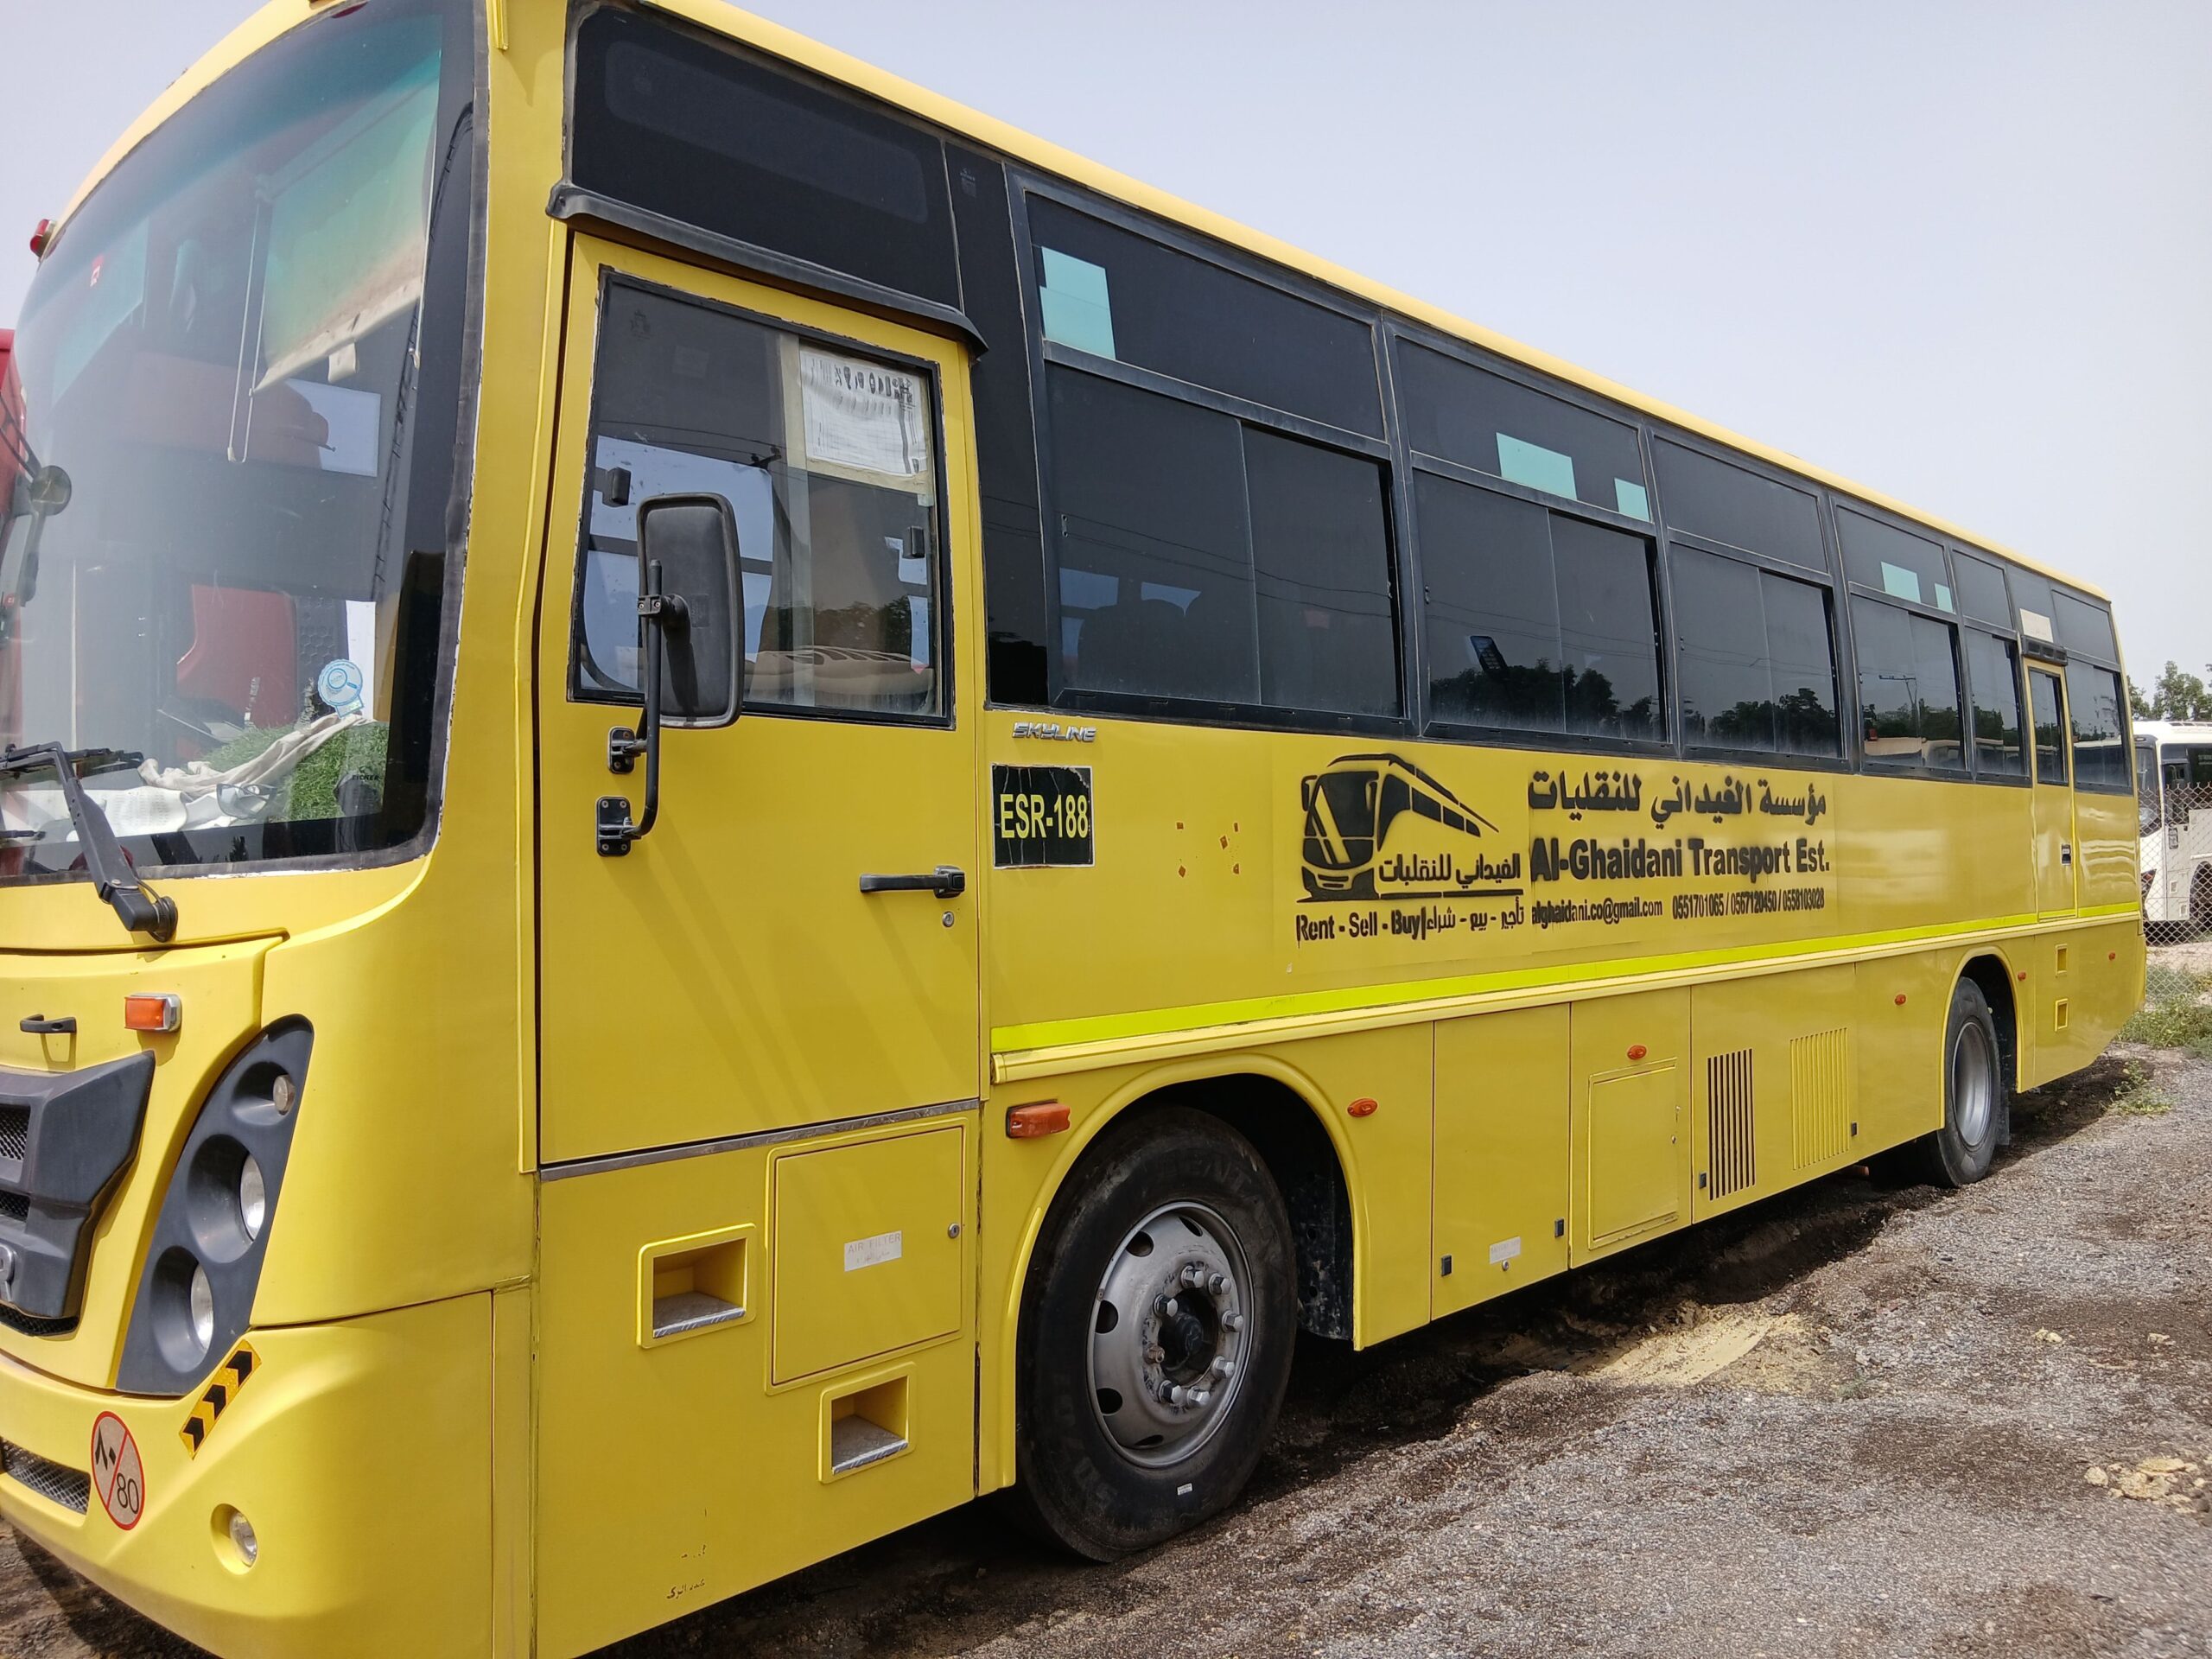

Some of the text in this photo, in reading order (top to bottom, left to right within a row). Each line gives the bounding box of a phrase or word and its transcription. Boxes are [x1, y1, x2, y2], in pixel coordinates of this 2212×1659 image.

[1012, 721, 1096, 742] SKYLINE
[1000, 793, 1088, 838] ESR-188
[1529, 770, 1827, 830] مؤسسة الغيداني للنقليات
[1530, 838, 1830, 883] Al-Ghaidani Transport Est.
[1296, 914, 1335, 941] Rent
[1349, 912, 1377, 938] Sell
[1532, 897, 1662, 929] alghaidani.co@gmail.com
[849, 1243, 864, 1253] AIR
[117, 1472, 139, 1515] 80
